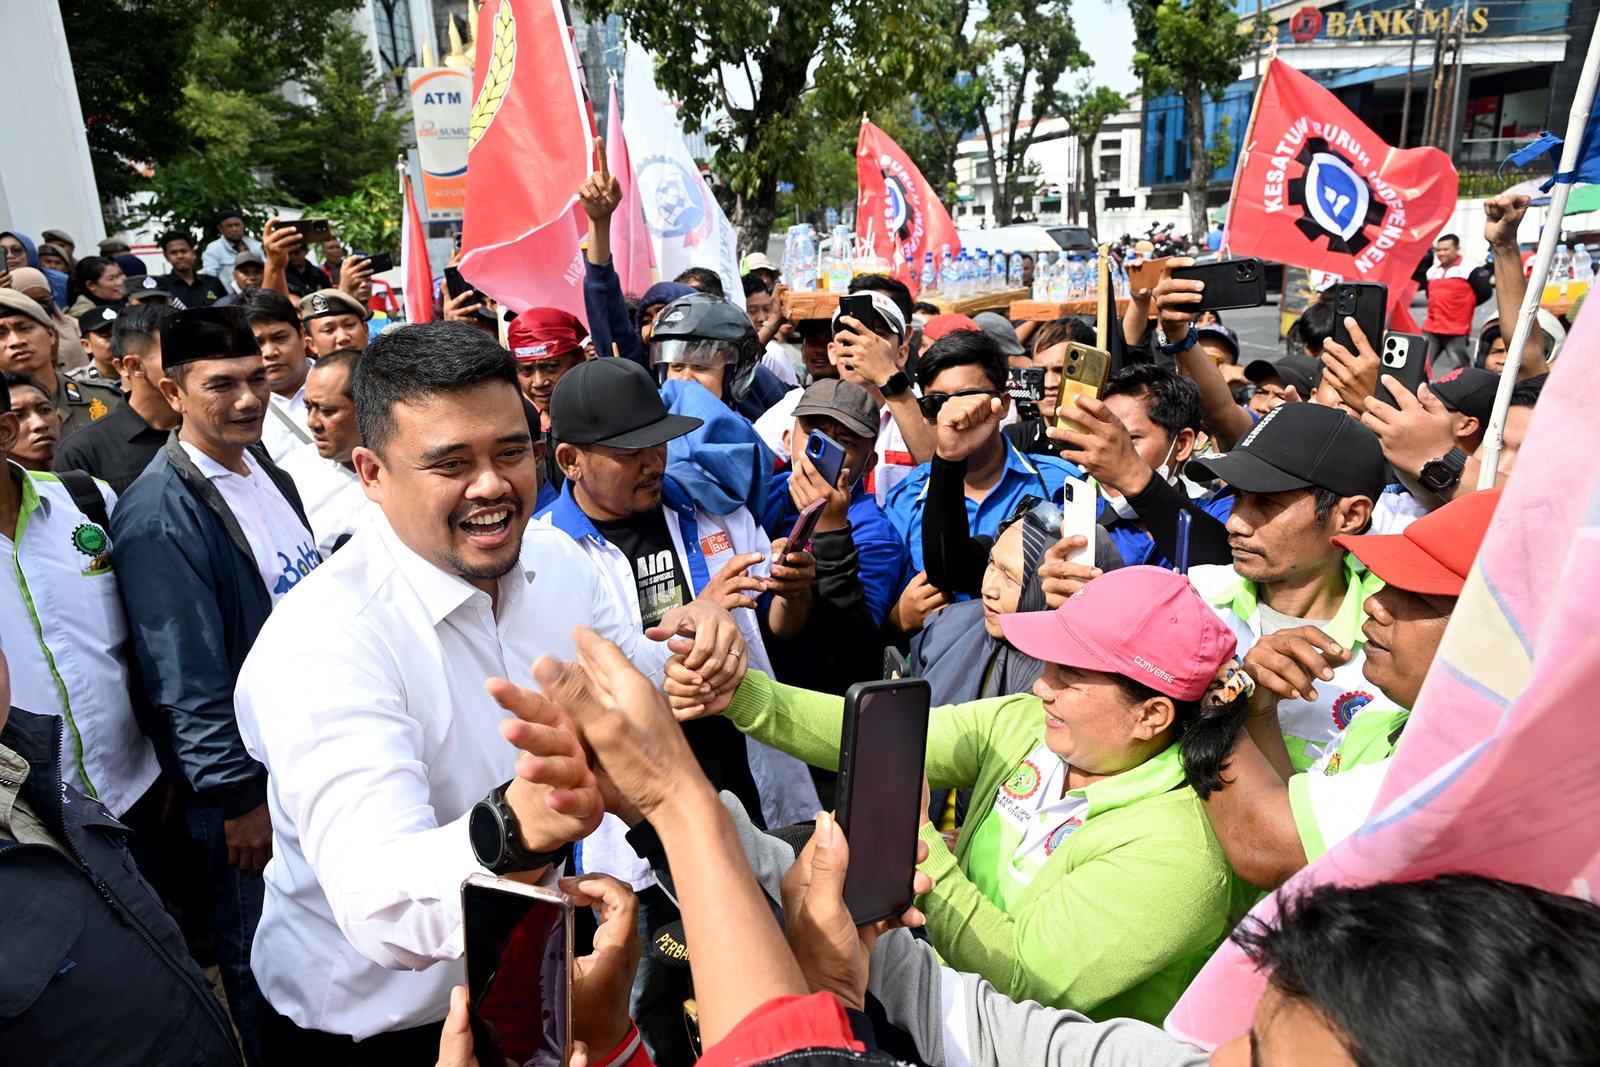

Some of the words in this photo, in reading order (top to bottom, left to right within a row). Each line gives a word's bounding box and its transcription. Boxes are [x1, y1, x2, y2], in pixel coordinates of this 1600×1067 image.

[1325, 10, 1415, 37] BANK
[1420, 7, 1489, 36] MAS
[424, 92, 461, 105] ATM
[439, 127, 470, 136] SUMU
[1311, 121, 1371, 167] BURUH
[1355, 170, 1406, 274] INDEPENDEN
[709, 533, 728, 545] Par
[712, 541, 732, 553] Bur
[1134, 655, 1175, 684] CONVERSE
[655, 932, 690, 961] PERBA
